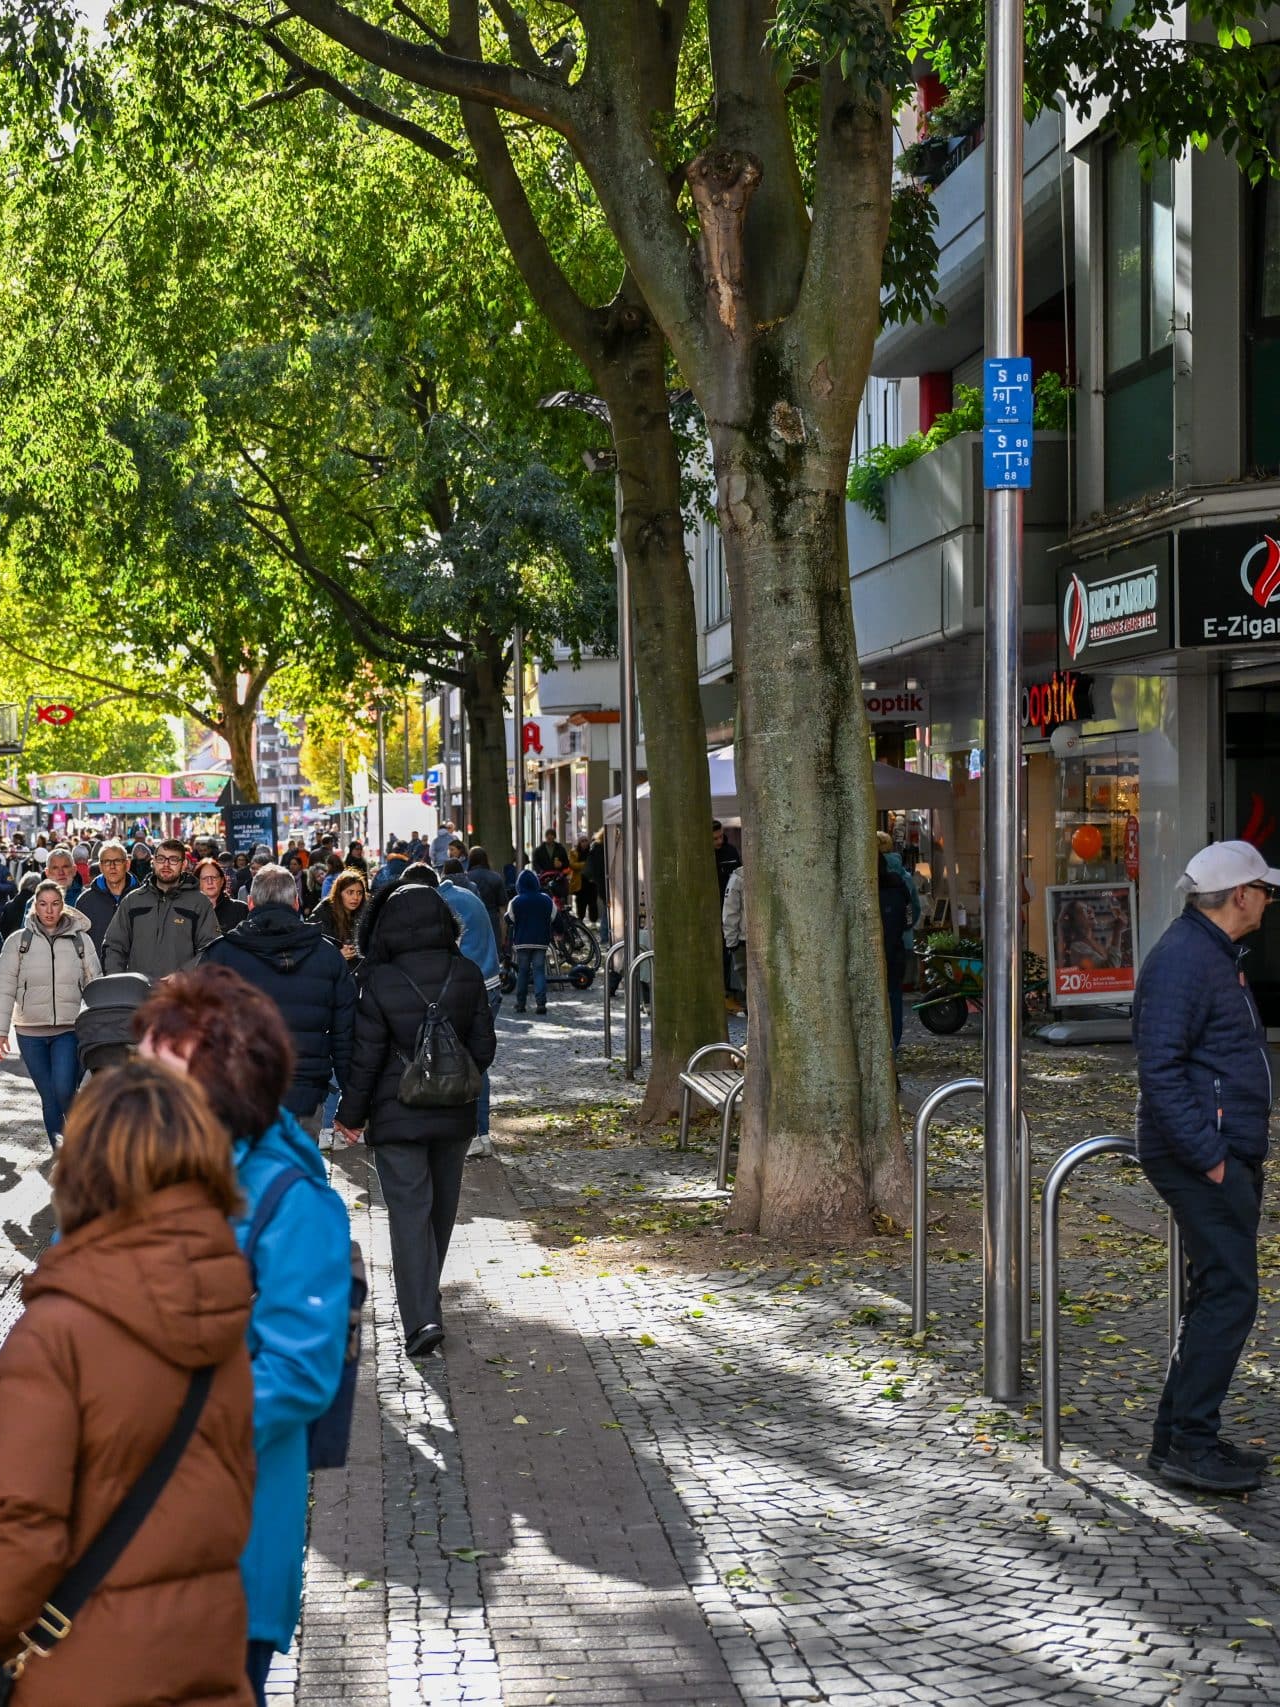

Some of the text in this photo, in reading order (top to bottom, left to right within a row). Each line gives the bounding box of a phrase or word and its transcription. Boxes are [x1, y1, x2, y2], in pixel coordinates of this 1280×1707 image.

[998, 370, 1007, 382] S
[997, 435, 1029, 448] S 80
[1089, 574, 1157, 624] RICCARDO
[867, 694, 924, 716] optik
[1029, 671, 1079, 737] optik
[1060, 974, 1093, 991] 20%
